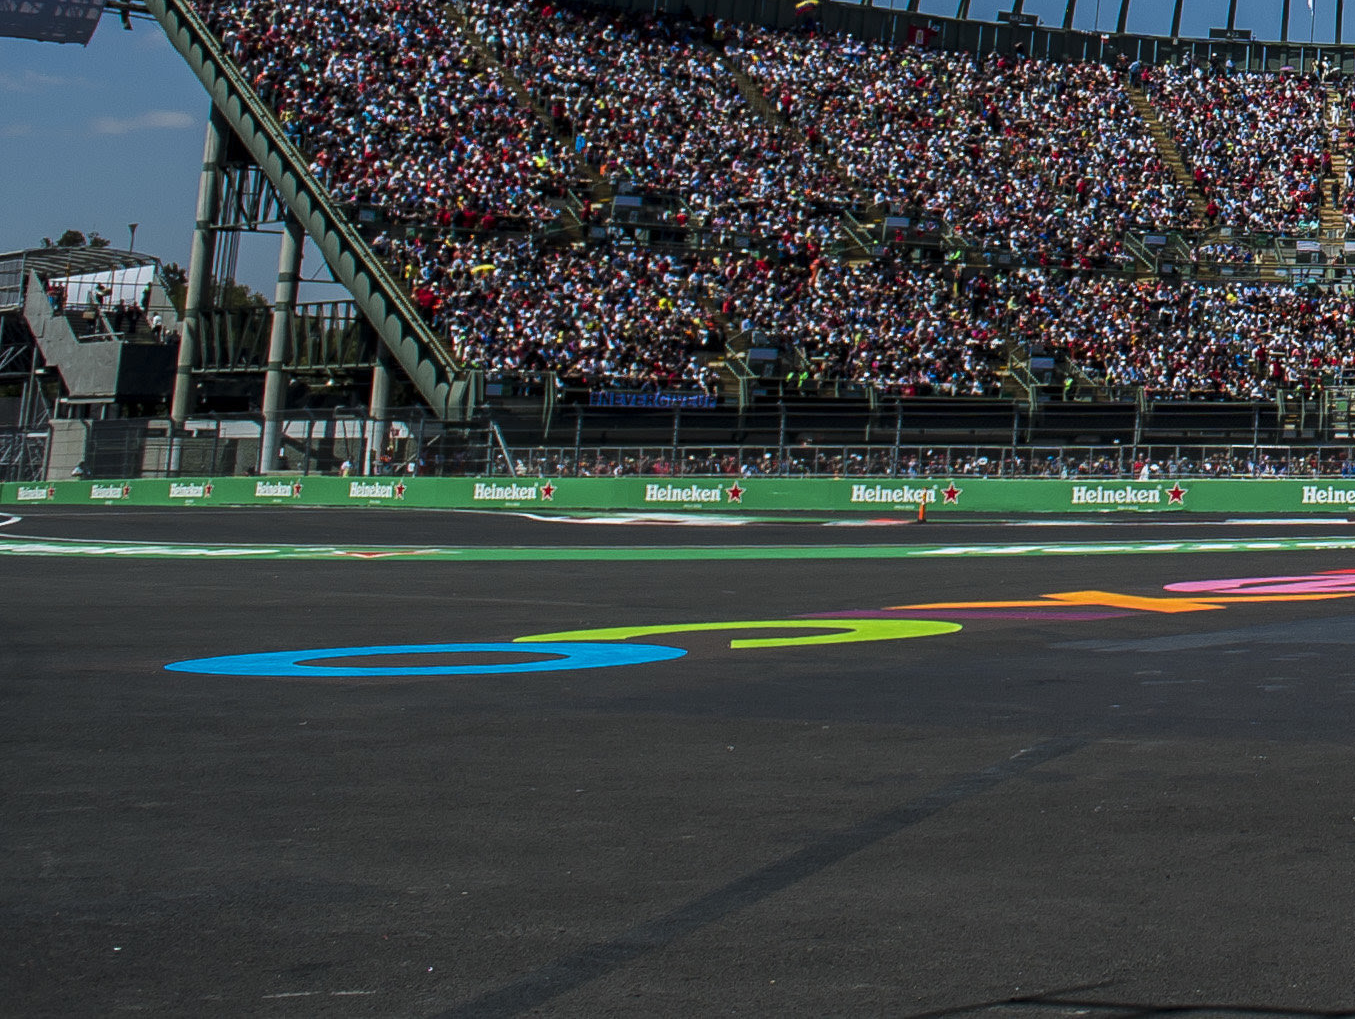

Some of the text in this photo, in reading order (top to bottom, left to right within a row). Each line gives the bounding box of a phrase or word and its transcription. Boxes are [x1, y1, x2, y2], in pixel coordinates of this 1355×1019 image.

[170, 483, 204, 497] Heineken
[256, 482, 291, 497] Heineken
[350, 482, 392, 497] Heineken
[474, 483, 537, 500] Heineken
[646, 484, 720, 502] Heineken
[851, 485, 936, 503] Heineken
[1072, 485, 1160, 504] Heineken
